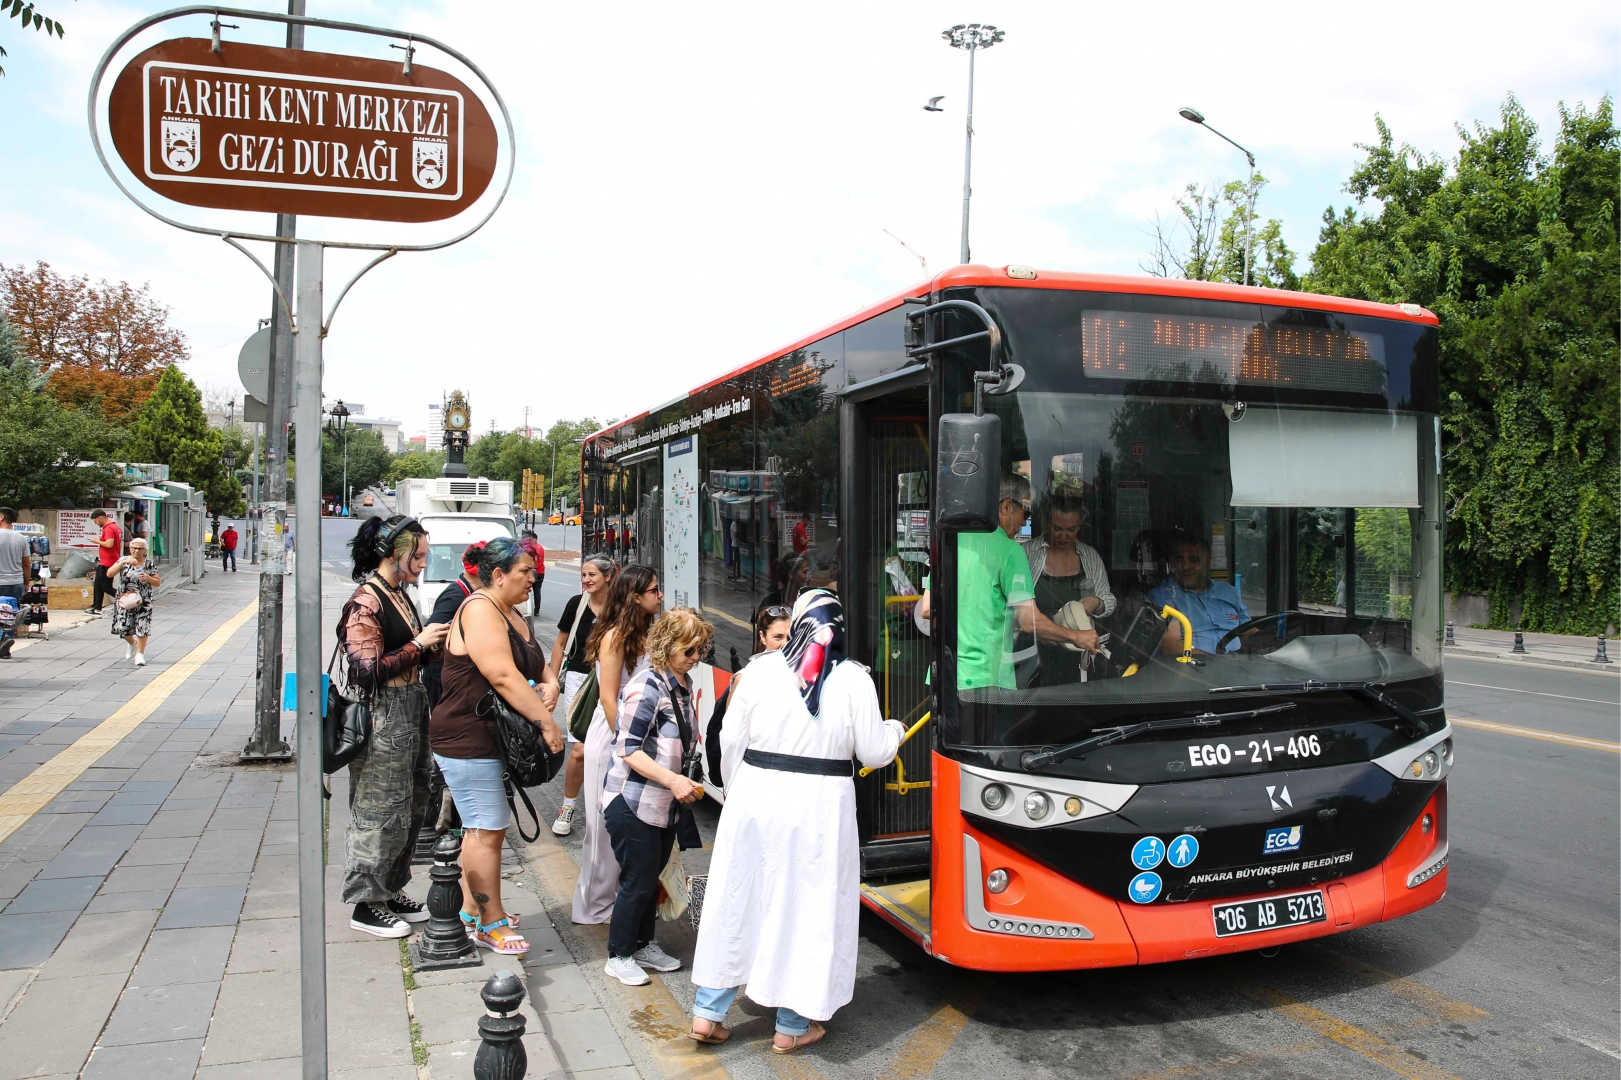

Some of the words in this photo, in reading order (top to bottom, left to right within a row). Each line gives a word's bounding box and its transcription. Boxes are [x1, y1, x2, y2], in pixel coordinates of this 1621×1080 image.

[161, 115, 200, 123] ANKARA
[258, 85, 329, 126] KENT
[413, 136, 448, 144] ANKARA
[293, 139, 399, 182] DURAĞI
[1266, 831, 1300, 849] EGO
[1189, 871, 1233, 884] ANKARA
[1236, 861, 1300, 879] BÜYÜKŞEHİR
[1302, 851, 1354, 870] BELEDİYESİ
[1225, 906, 1247, 932] 06
[1258, 902, 1277, 927] AB
[1287, 894, 1323, 922] 5213
